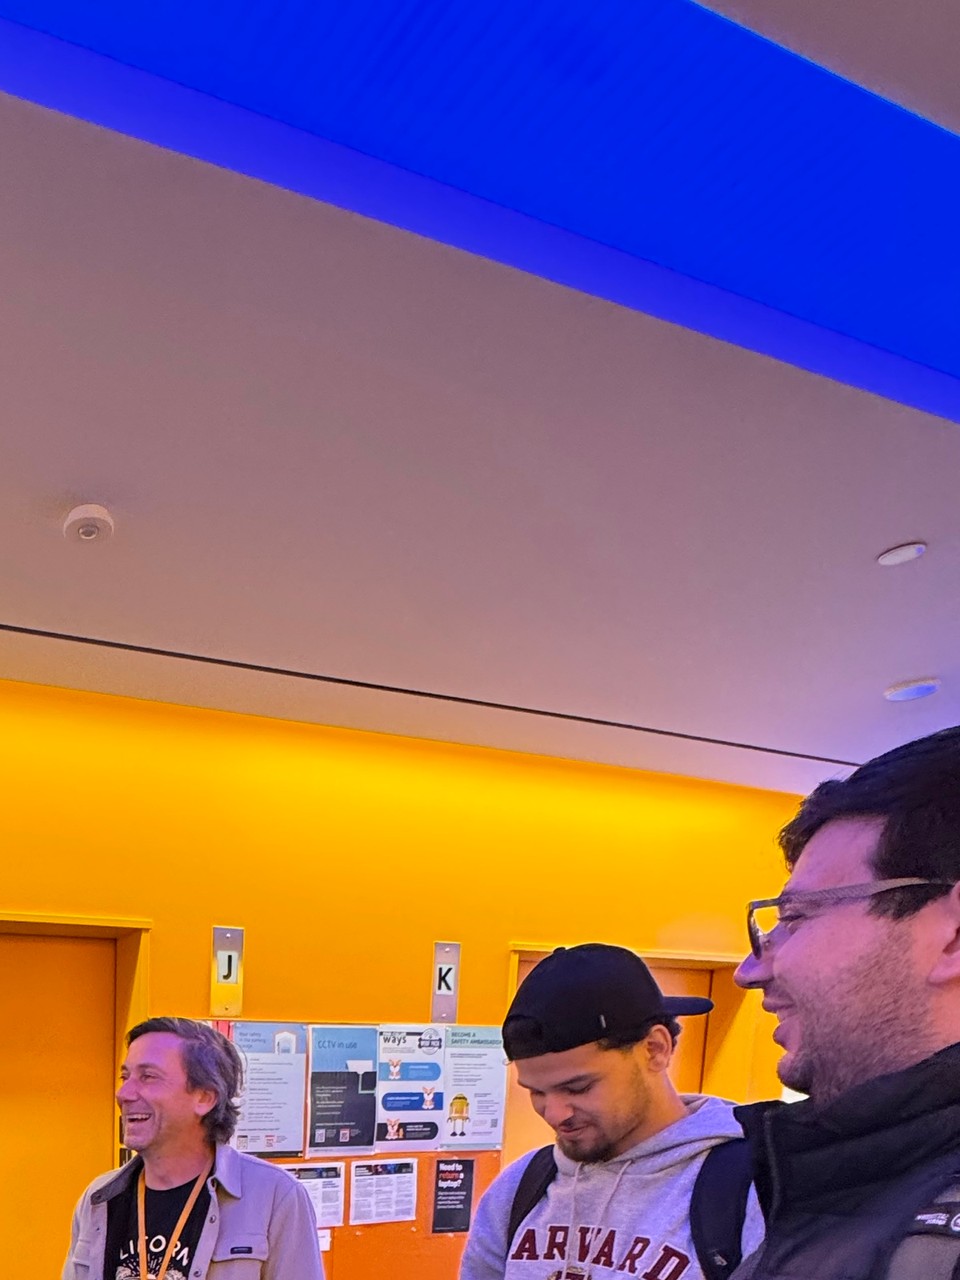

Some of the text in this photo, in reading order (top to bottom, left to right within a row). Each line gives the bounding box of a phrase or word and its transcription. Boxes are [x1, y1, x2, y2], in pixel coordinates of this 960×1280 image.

[223, 954, 232, 980] J
[438, 967, 453, 991] K
[318, 1040, 357, 1049] CCTV in use
[383, 1036, 407, 1046] ways
[439, 1163, 463, 1171] Need to
[439, 1171, 459, 1179] return
[438, 1179, 462, 1189] laptop?
